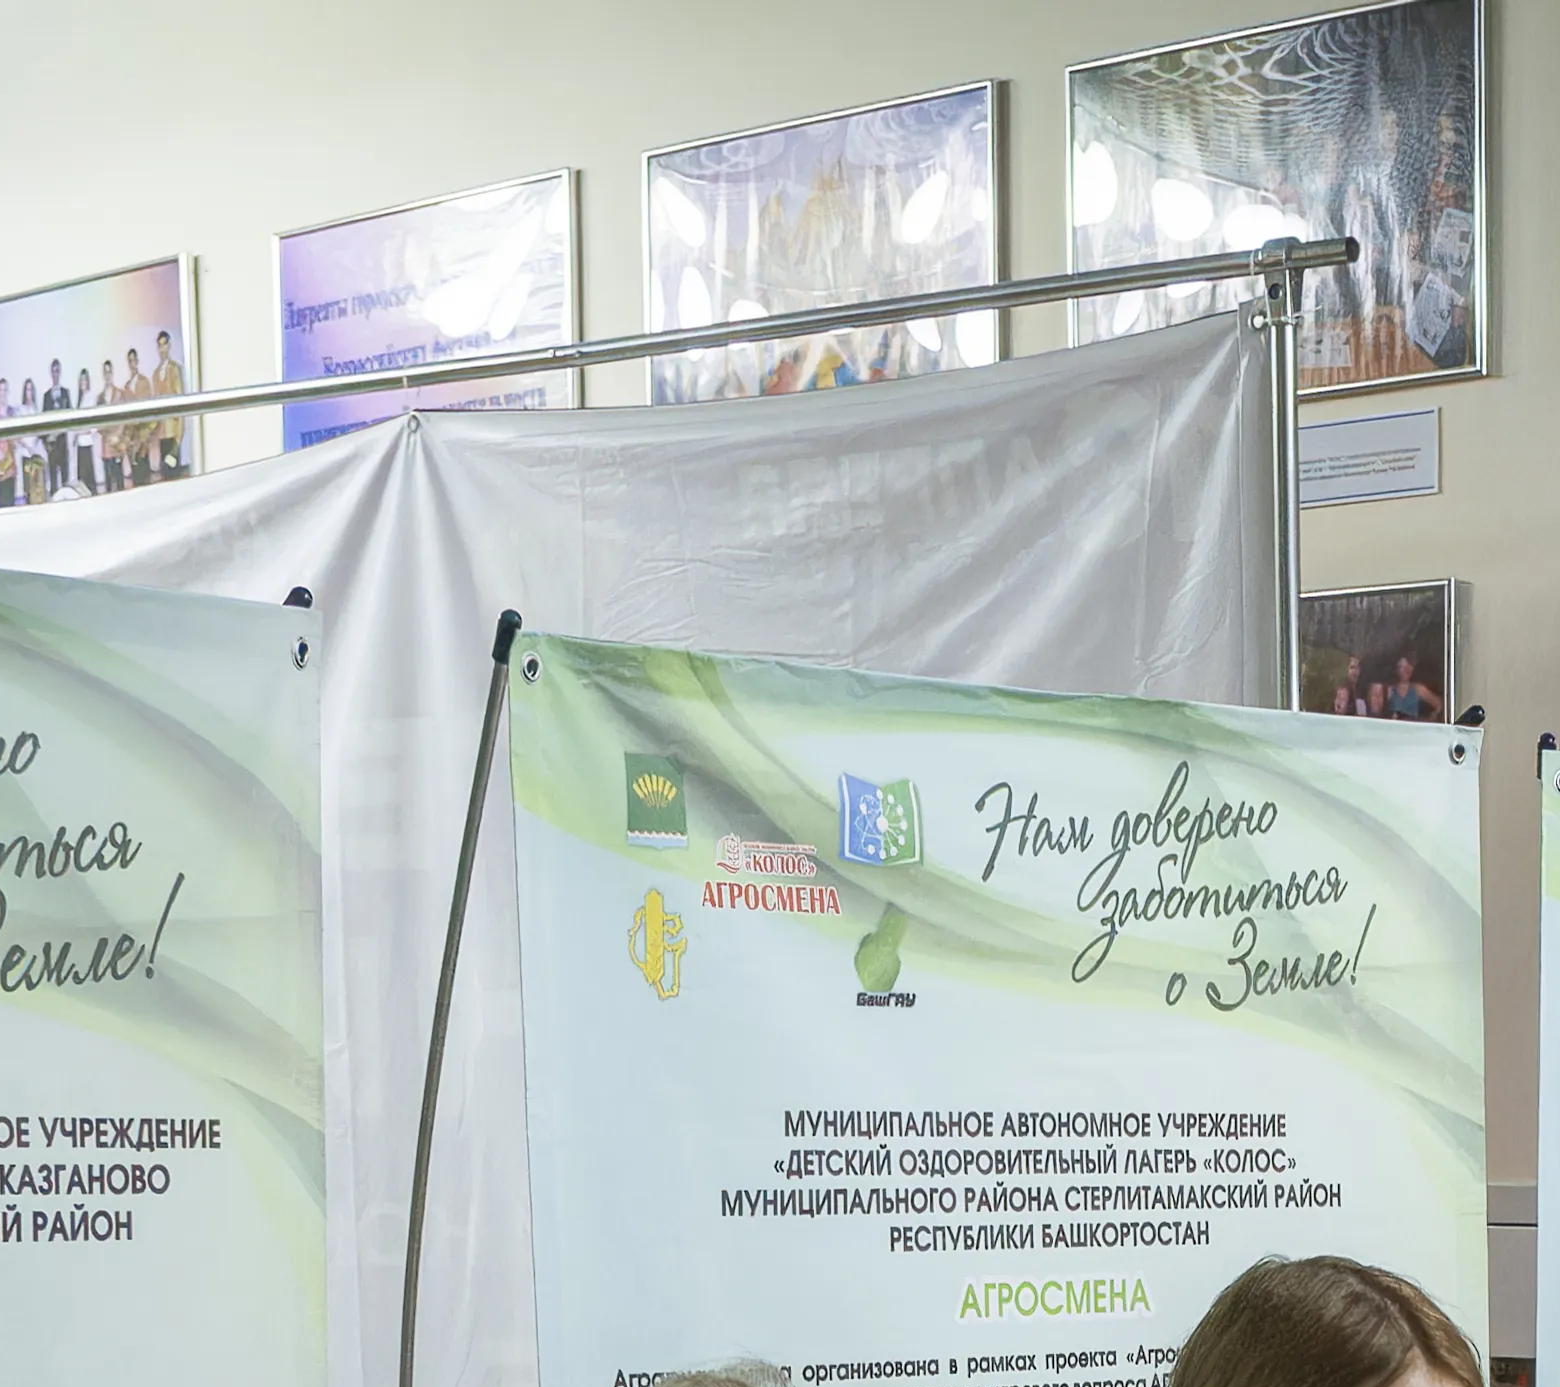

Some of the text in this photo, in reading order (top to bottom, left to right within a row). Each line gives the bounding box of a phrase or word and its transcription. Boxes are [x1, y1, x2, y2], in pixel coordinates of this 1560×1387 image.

[976, 761, 1278, 911] Нам доверено
[745, 852, 816, 877] «КОЛОС»
[702, 881, 842, 915] АГРОСМЕНА
[1072, 857, 1349, 984] заботиться
[1165, 905, 1379, 1012] о Земле!
[40, 1117, 222, 1152] УЧРЕЖДЕНИЕ
[784, 1110, 1287, 1141] МУНИЦИПАЛЬНОЕ АВТОНОМНОЕ УЧРЕЖДЕНИЕ
[773, 1142, 1297, 1180] «ДЕТСКИЙ ОЗДОРОВИТЕЛЬНЫЙ ЛАГЕРЬ «КОЛОС»
[721, 1176, 1342, 1218] МУНИЦИПАЛЬНОГО РАЙОНА СТЕРЛИТАМАКСКИЙ РАЙОН
[33, 1203, 134, 1242] РАЙОН
[889, 1220, 1210, 1252] РЕСПУБЛИКИ БАШКОРТОСТАН
[959, 1278, 1151, 1319] АГРОСМЕНА
[802, 1349, 1117, 1385] организована рамках проекта
